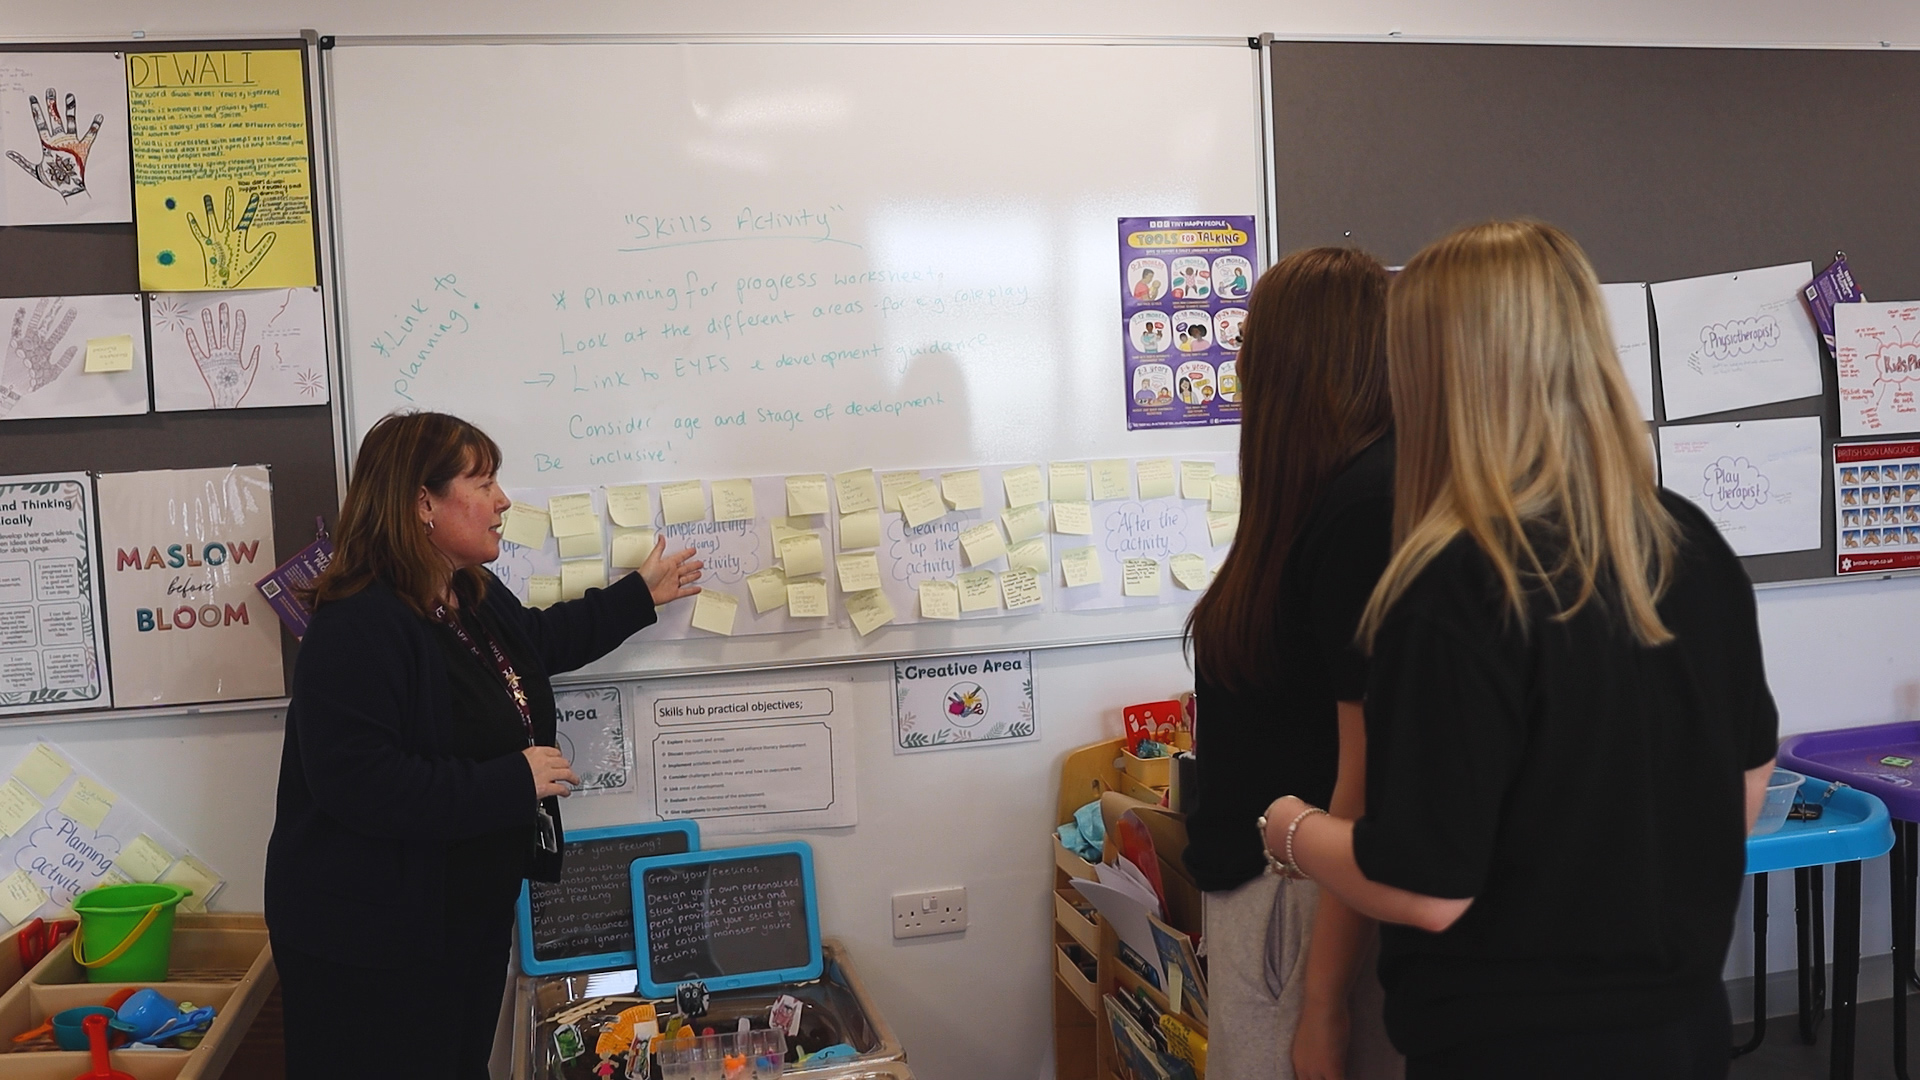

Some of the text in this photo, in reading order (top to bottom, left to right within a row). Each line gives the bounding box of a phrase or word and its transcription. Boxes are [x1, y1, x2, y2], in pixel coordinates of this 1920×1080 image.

[131, 52, 255, 87] DIWALI
[1136, 231, 1240, 246] TOOLS FOR TALKING
[686, 271, 718, 309] for
[737, 272, 817, 304] progress
[384, 299, 429, 347] Link
[561, 332, 608, 355] Look
[624, 327, 648, 343] at
[661, 323, 692, 339] the
[707, 310, 796, 340] different
[812, 300, 863, 318] areas
[1709, 322, 1774, 354] Physiotherapist
[573, 365, 629, 392] Link
[641, 368, 659, 381] to
[775, 343, 883, 369] development
[896, 334, 988, 374] guidance
[674, 416, 702, 440] age
[715, 411, 747, 426] and
[813, 402, 835, 422] of
[845, 392, 945, 417] development
[1837, 446, 1915, 458] BRITISH SIGN LANGUAGE
[535, 453, 565, 473] Be
[1715, 468, 1740, 489] Play
[1718, 485, 1761, 504] therapist
[0, 499, 72, 512] nd Thinking
[0, 514, 33, 527] ically
[1118, 511, 1179, 537] After the
[909, 541, 927, 557] up
[934, 538, 955, 551] the
[1120, 535, 1169, 557] activity
[117, 540, 260, 572] MASLOW
[906, 558, 956, 580] activity
[167, 574, 214, 598] before
[136, 602, 250, 632] BLOOM
[905, 659, 1023, 680] Creative Area
[659, 700, 803, 718] Skills hub practical objectives;
[57, 818, 113, 877] Planning
[565, 847, 585, 857] are
[592, 845, 613, 860] you
[62, 852, 84, 873] an
[589, 863, 613, 873] with
[648, 874, 678, 884] Grow
[682, 870, 707, 884] your
[532, 881, 619, 900] about how much
[648, 878, 799, 906] Design your own personalised
[677, 901, 705, 912] using
[710, 898, 727, 908] the
[767, 889, 787, 899] and
[534, 916, 554, 926] Full
[649, 899, 796, 930] pens provided around the
[722, 915, 744, 929] your
[778, 911, 791, 921] by
[584, 919, 629, 932] Balanced
[652, 942, 669, 952] the
[675, 934, 710, 946] colour
[713, 925, 757, 938] monster
